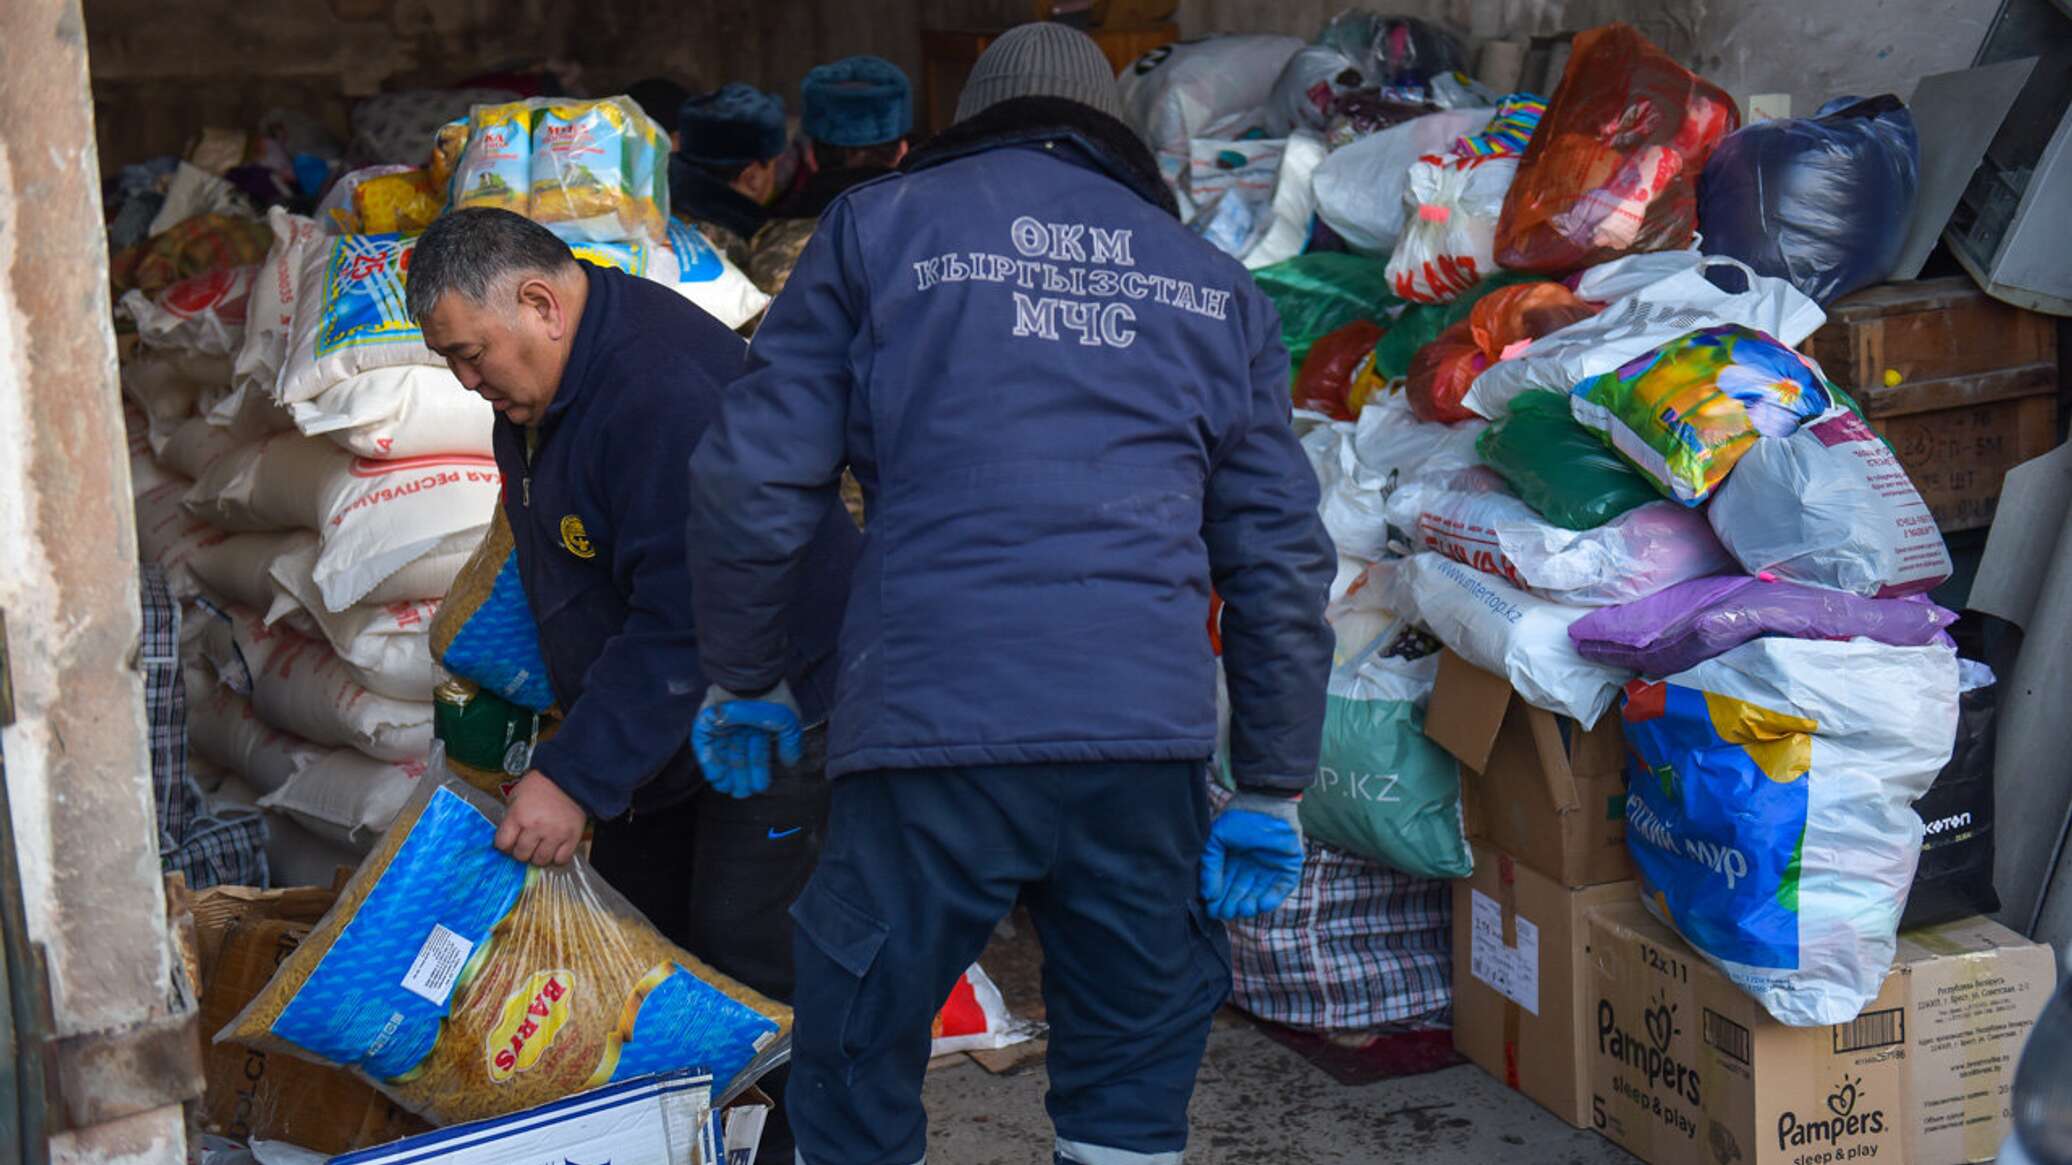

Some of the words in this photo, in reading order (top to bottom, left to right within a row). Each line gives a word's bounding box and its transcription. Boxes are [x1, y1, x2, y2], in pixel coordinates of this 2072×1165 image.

[913, 252, 1231, 320] КЫРГЫЗСТАН
[1012, 292, 1137, 348] МЧС
[495, 977, 566, 1072] BARYS
[1598, 998, 1701, 1107] Pampers
[1593, 1094, 1607, 1129] 5
[1612, 1075, 1649, 1110] sleep
[1652, 1096, 1661, 1115] &
[1664, 1105, 1697, 1139] play
[1778, 1110, 1884, 1151] Pampers
[1794, 1152, 1832, 1165] sleep
[1835, 1148, 1845, 1161] &
[1847, 1144, 1878, 1161] play
